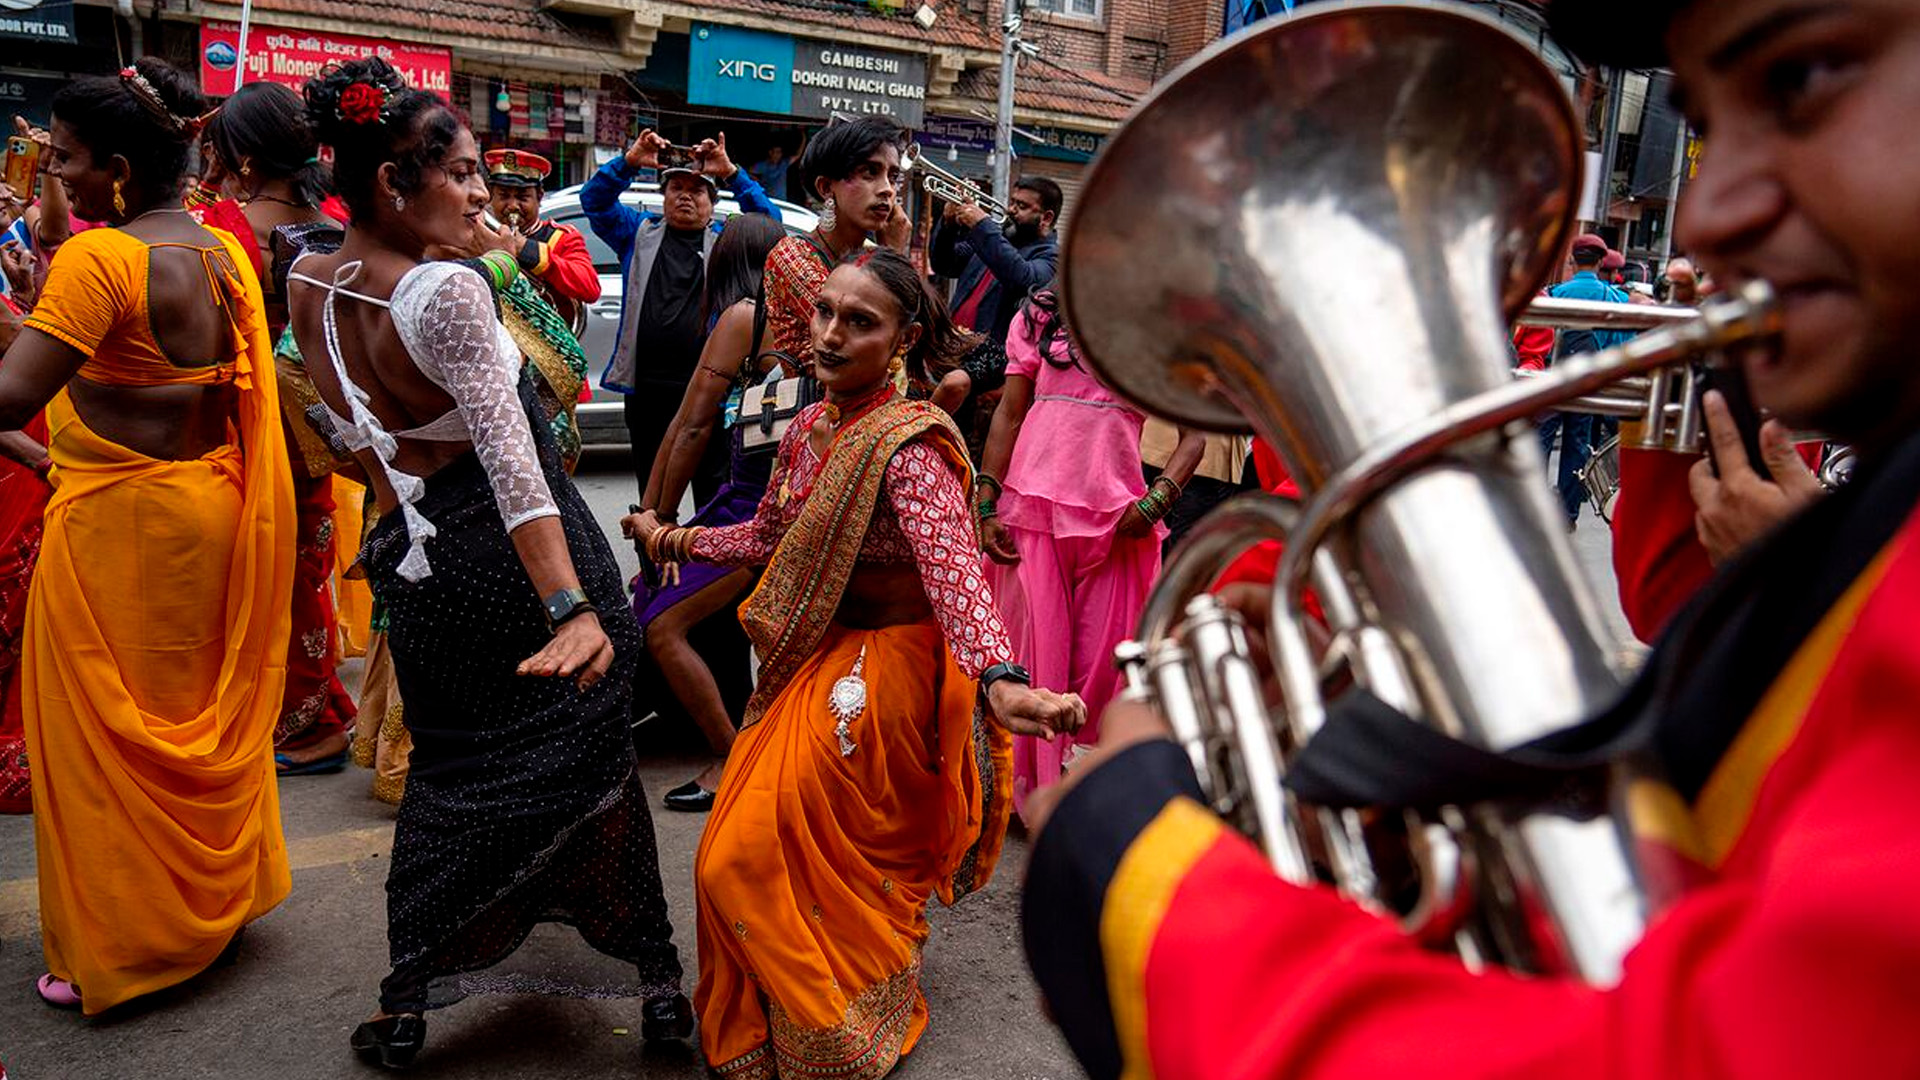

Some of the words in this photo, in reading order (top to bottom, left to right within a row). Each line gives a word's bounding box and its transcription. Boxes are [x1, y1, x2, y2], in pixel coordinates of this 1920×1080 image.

[47, 24, 69, 37] LTD.
[273, 53, 323, 80] Money
[422, 69, 449, 91] Ltd.
[718, 58, 776, 81] XING
[821, 51, 899, 73] GAMBESHI
[792, 69, 843, 89] DOHORI
[847, 76, 885, 94] NACH
[888, 82, 925, 99] GHAR
[822, 96, 857, 112] PVT.
[863, 101, 896, 116] LTD.
